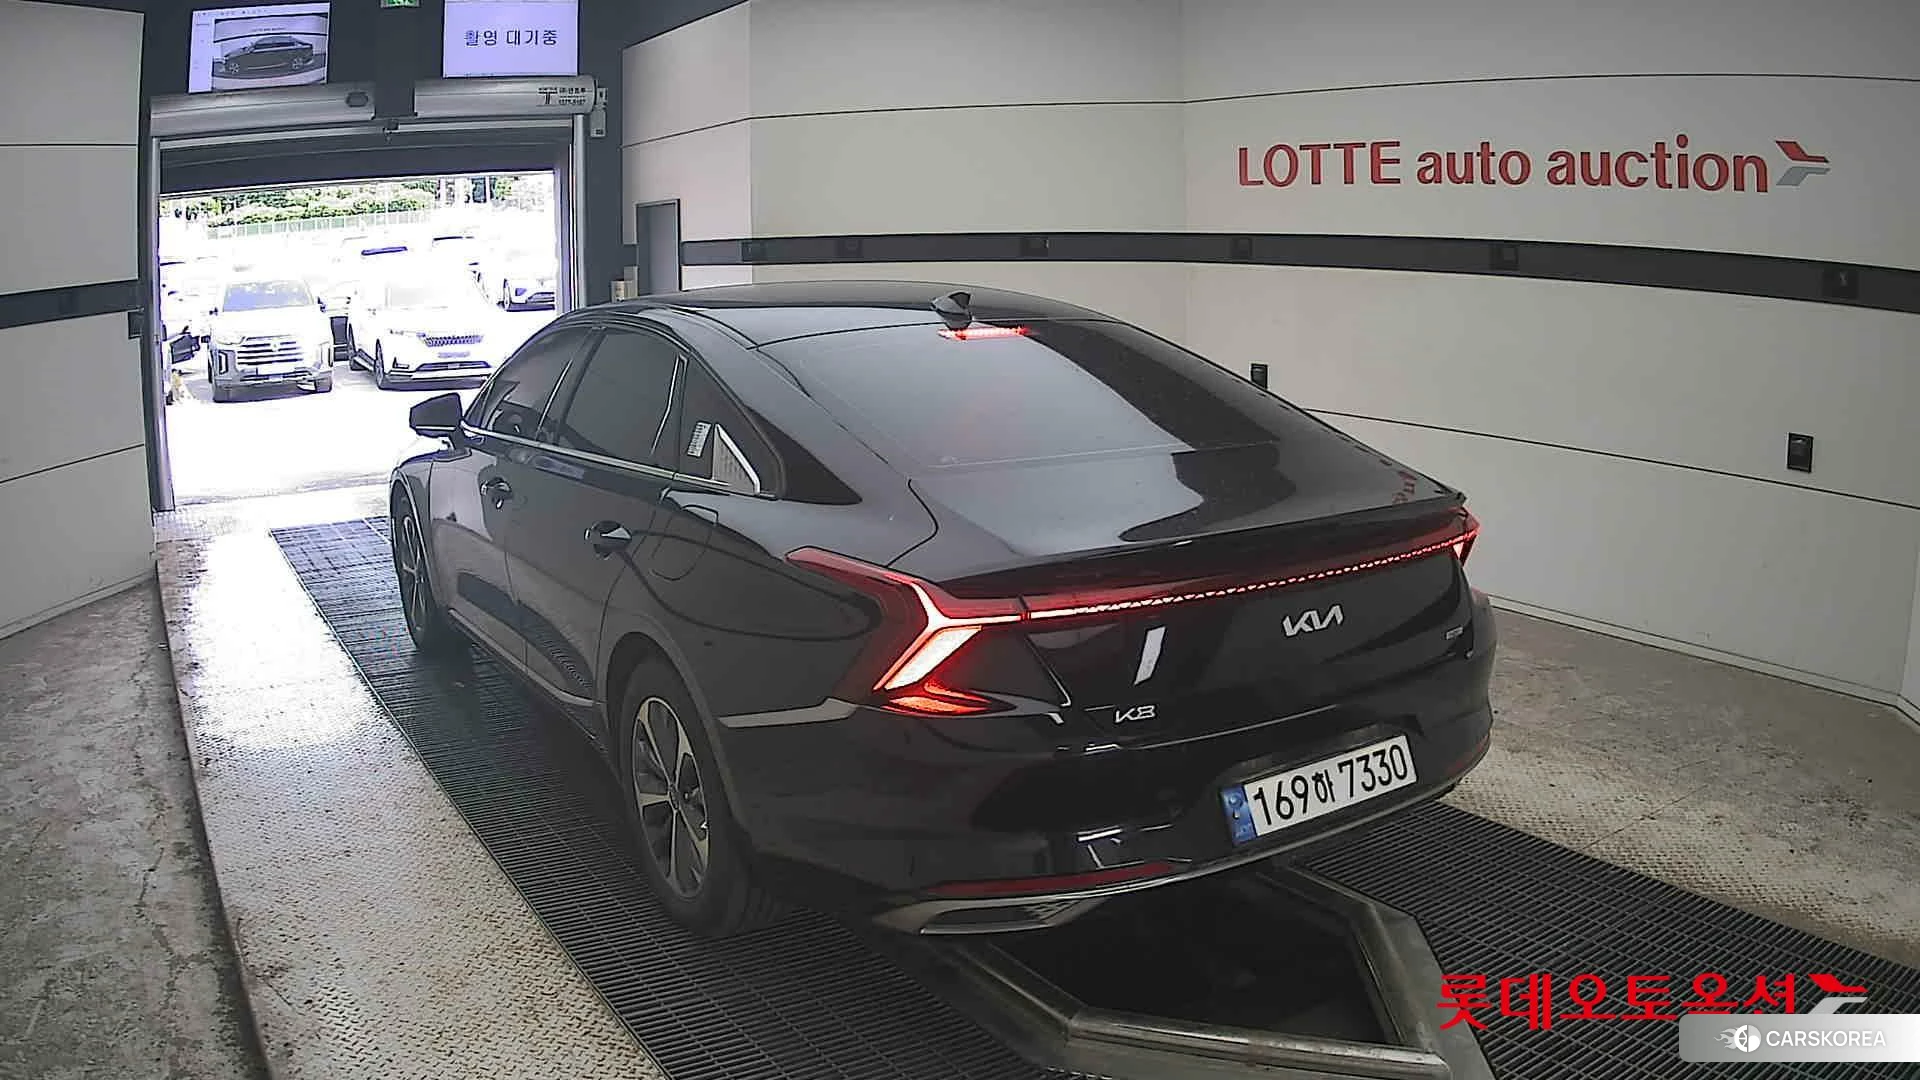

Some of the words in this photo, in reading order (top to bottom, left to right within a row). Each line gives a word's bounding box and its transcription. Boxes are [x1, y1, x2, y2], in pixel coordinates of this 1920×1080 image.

[464, 30, 498, 47] 촬영
[506, 29, 558, 46] 대기중
[1238, 140, 1401, 188] LOTTE
[1416, 143, 1532, 185] auto
[1547, 134, 1769, 192] auction
[1282, 604, 1344, 637] KIA
[1115, 705, 1156, 723] K8
[1253, 769, 1336, 825] 169하
[1337, 744, 1407, 799] 7330
